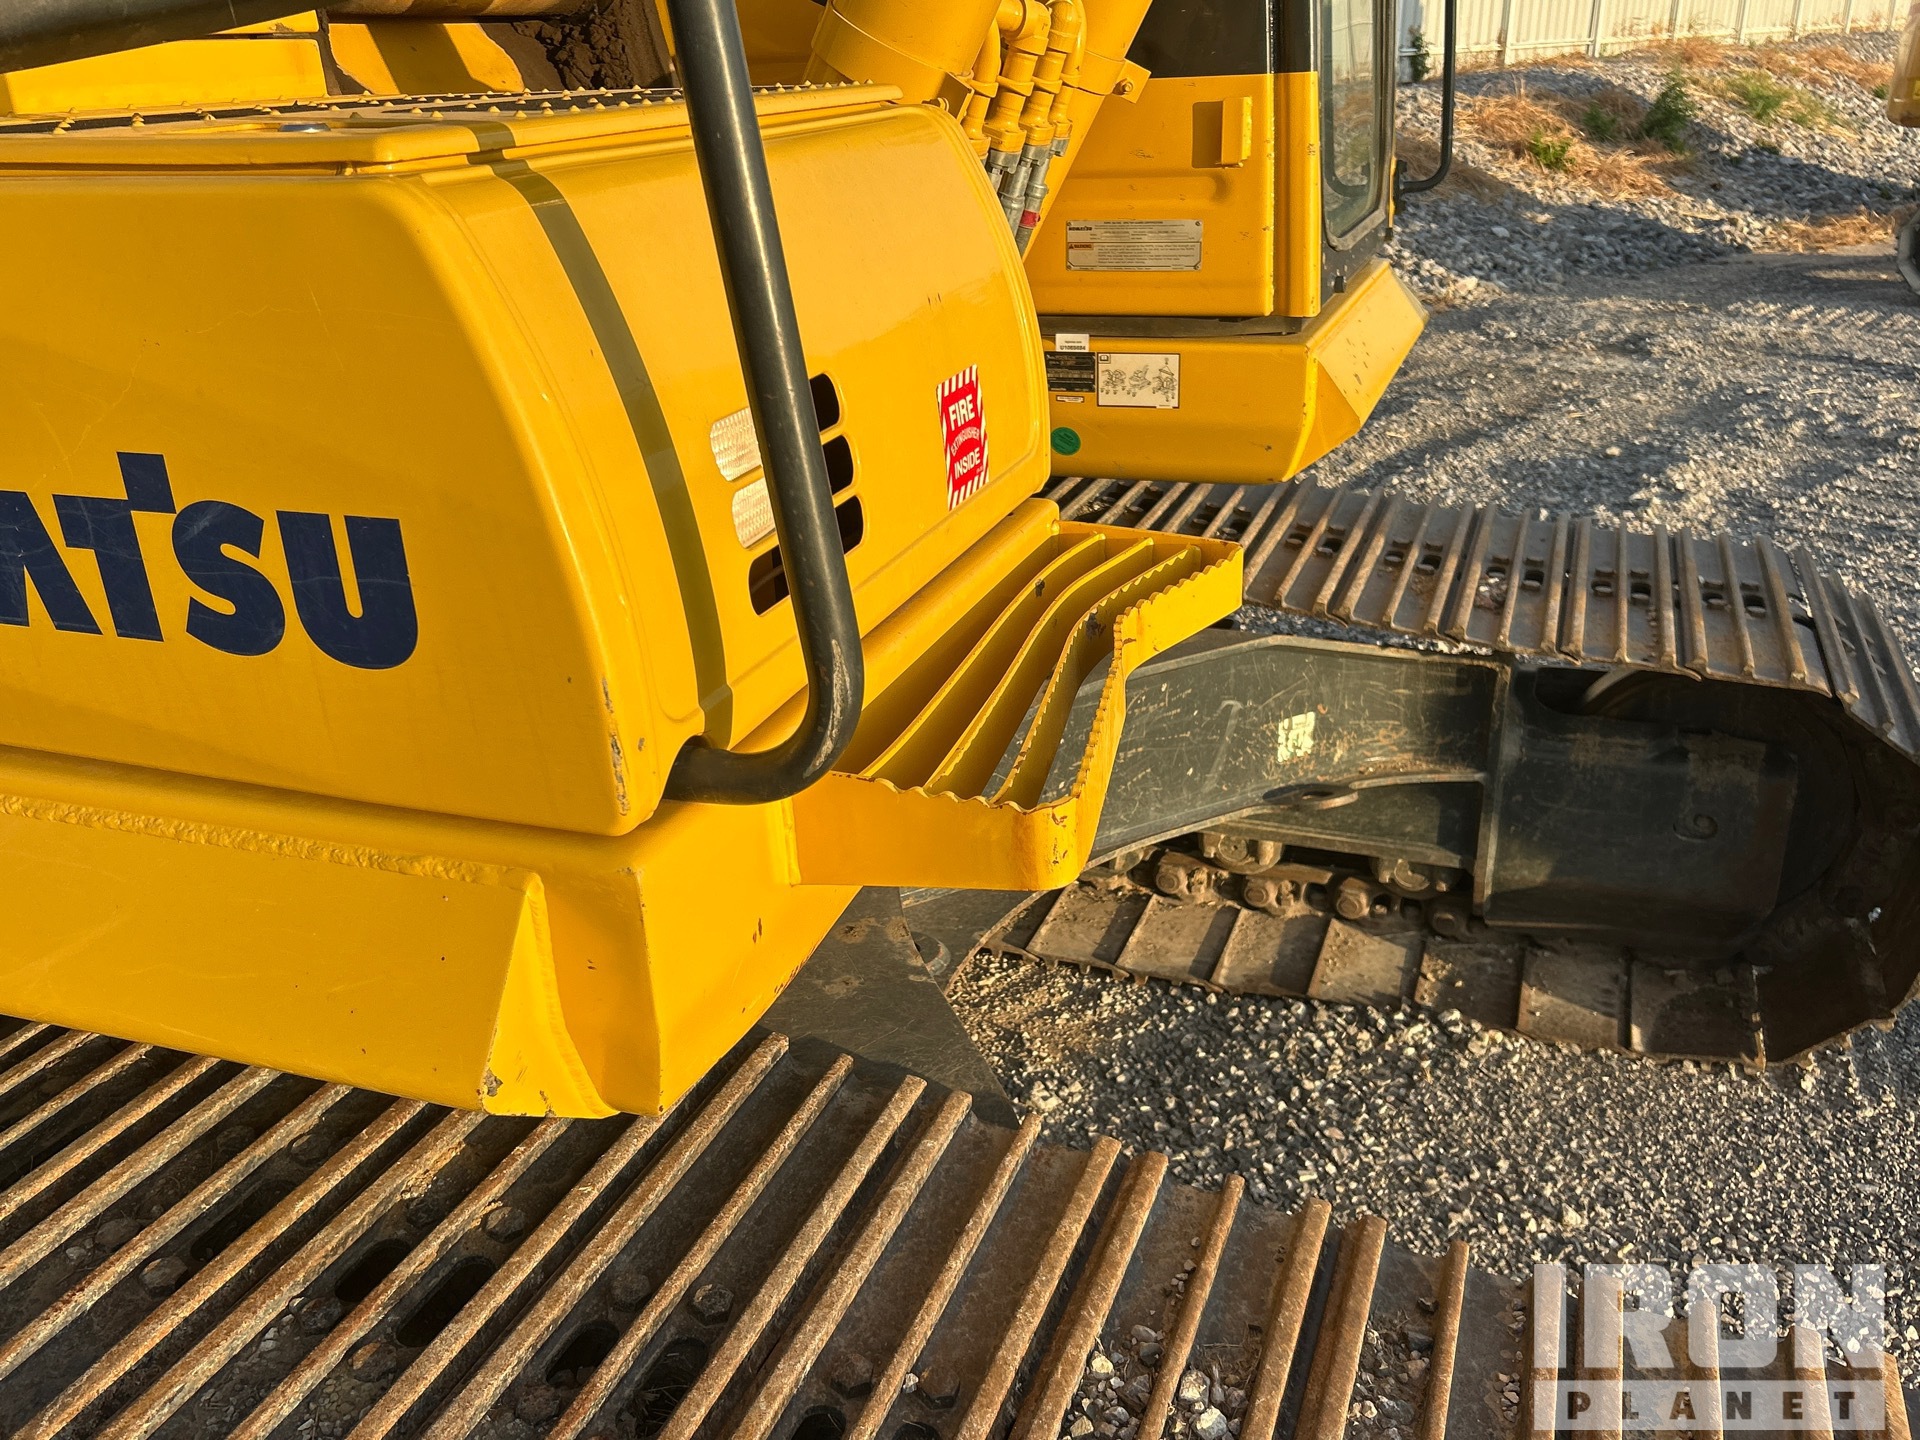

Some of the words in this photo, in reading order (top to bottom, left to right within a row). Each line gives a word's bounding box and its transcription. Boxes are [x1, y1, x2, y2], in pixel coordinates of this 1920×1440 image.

[948, 393, 976, 431] FIRE
[950, 426, 980, 457] EXTINGUISHER
[953, 448, 981, 480] INSIDE
